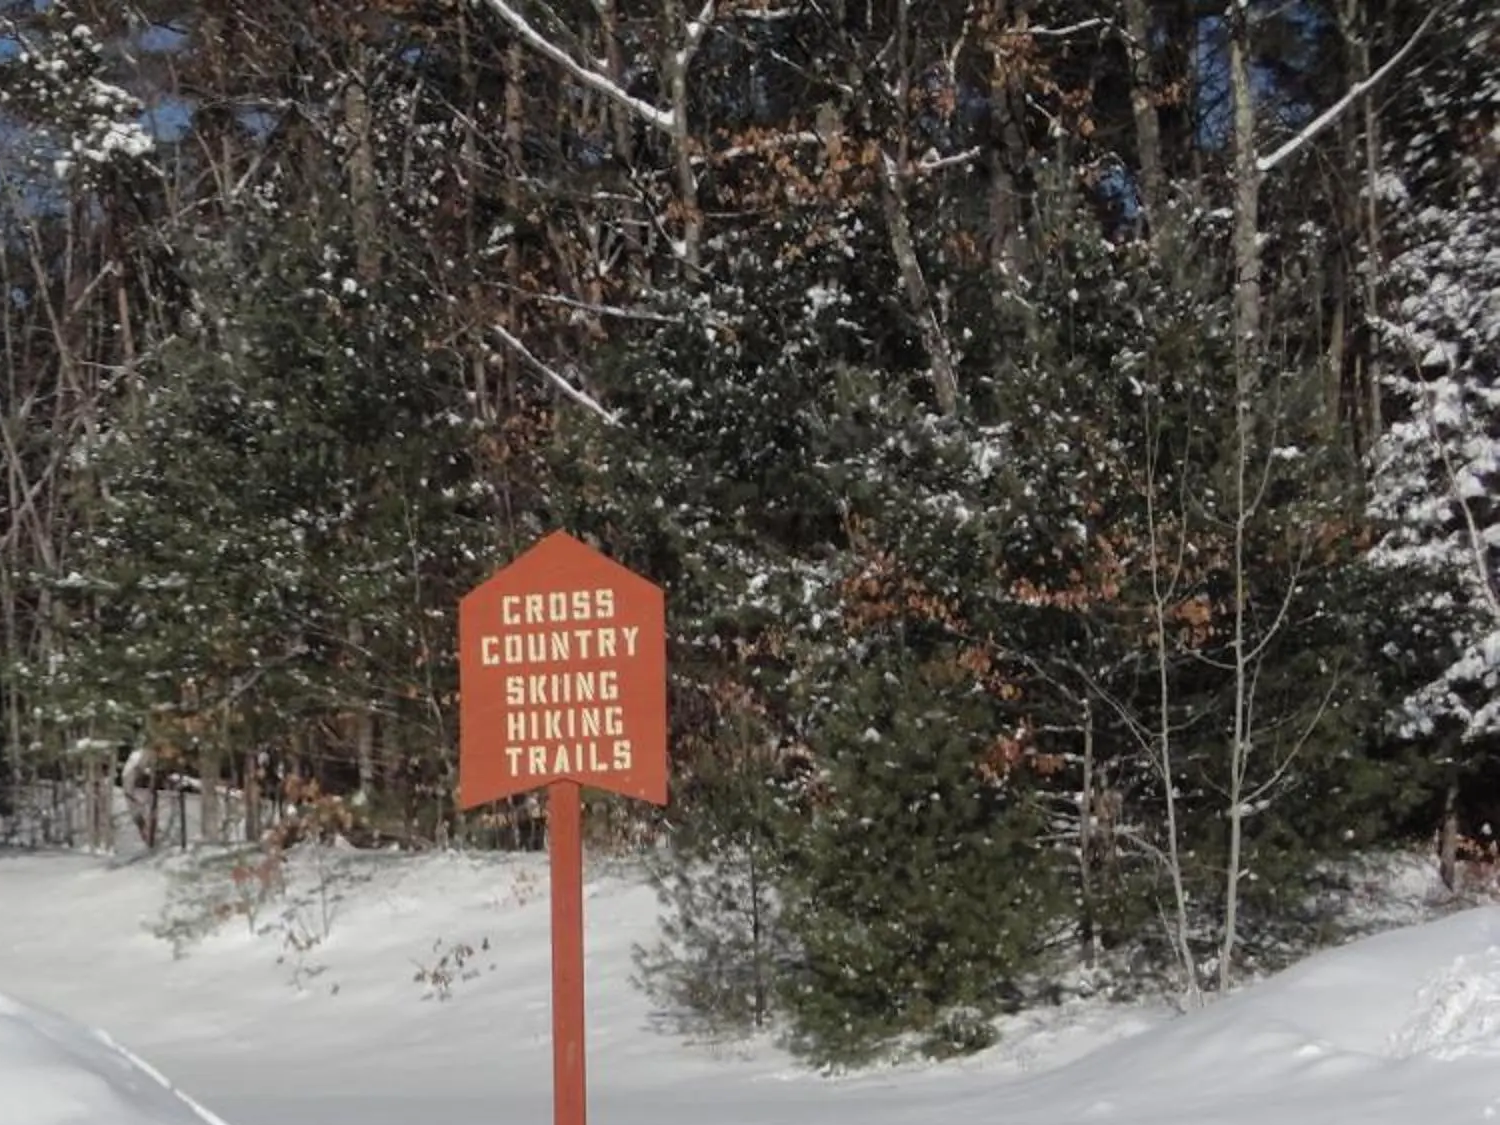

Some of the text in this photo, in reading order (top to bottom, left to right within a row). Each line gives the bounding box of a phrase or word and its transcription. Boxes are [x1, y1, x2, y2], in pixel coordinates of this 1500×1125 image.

[502, 588, 615, 625] CROSS
[481, 626, 640, 665] COUNTRY
[506, 670, 619, 705] SKIING
[507, 706, 623, 741] HIKING
[505, 740, 632, 777] TRAILS
